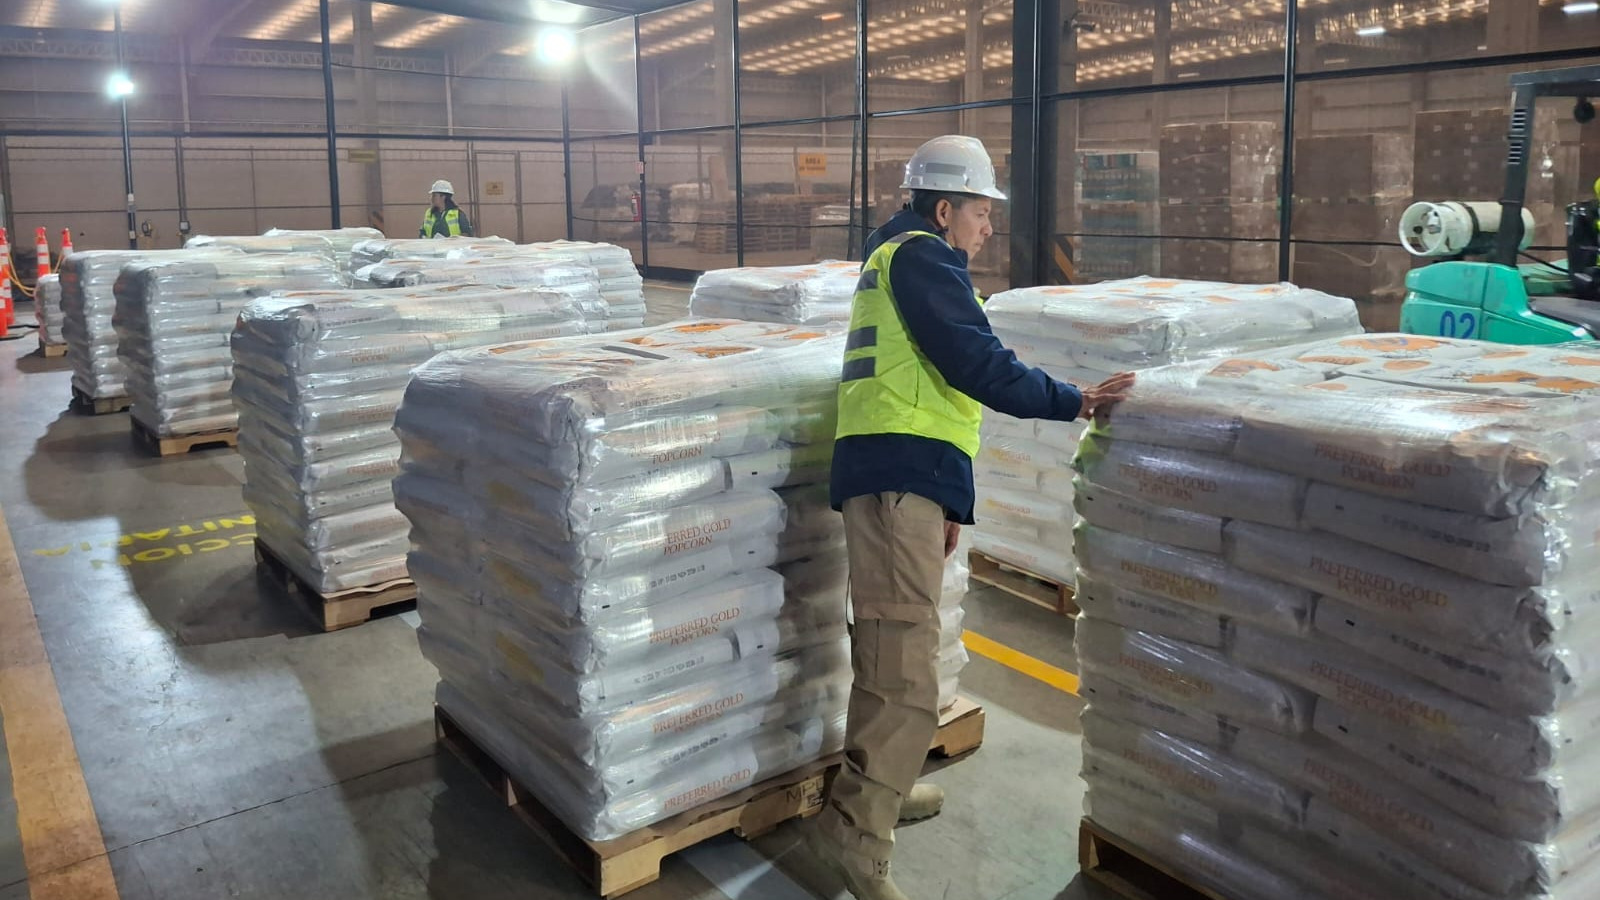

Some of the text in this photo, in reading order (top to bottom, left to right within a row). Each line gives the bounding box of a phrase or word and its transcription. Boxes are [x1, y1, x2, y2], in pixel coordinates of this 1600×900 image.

[1440, 310, 1475, 339] 02
[652, 446, 703, 465] POPCORN
[702, 518, 731, 534] GOLD
[663, 534, 713, 556] POPCORN
[650, 606, 740, 644] PREFERRED GOLD
[653, 692, 744, 734] PREFERRED GOLD
[663, 780, 722, 810] PREFERRED
[721, 768, 752, 789] GOLD
